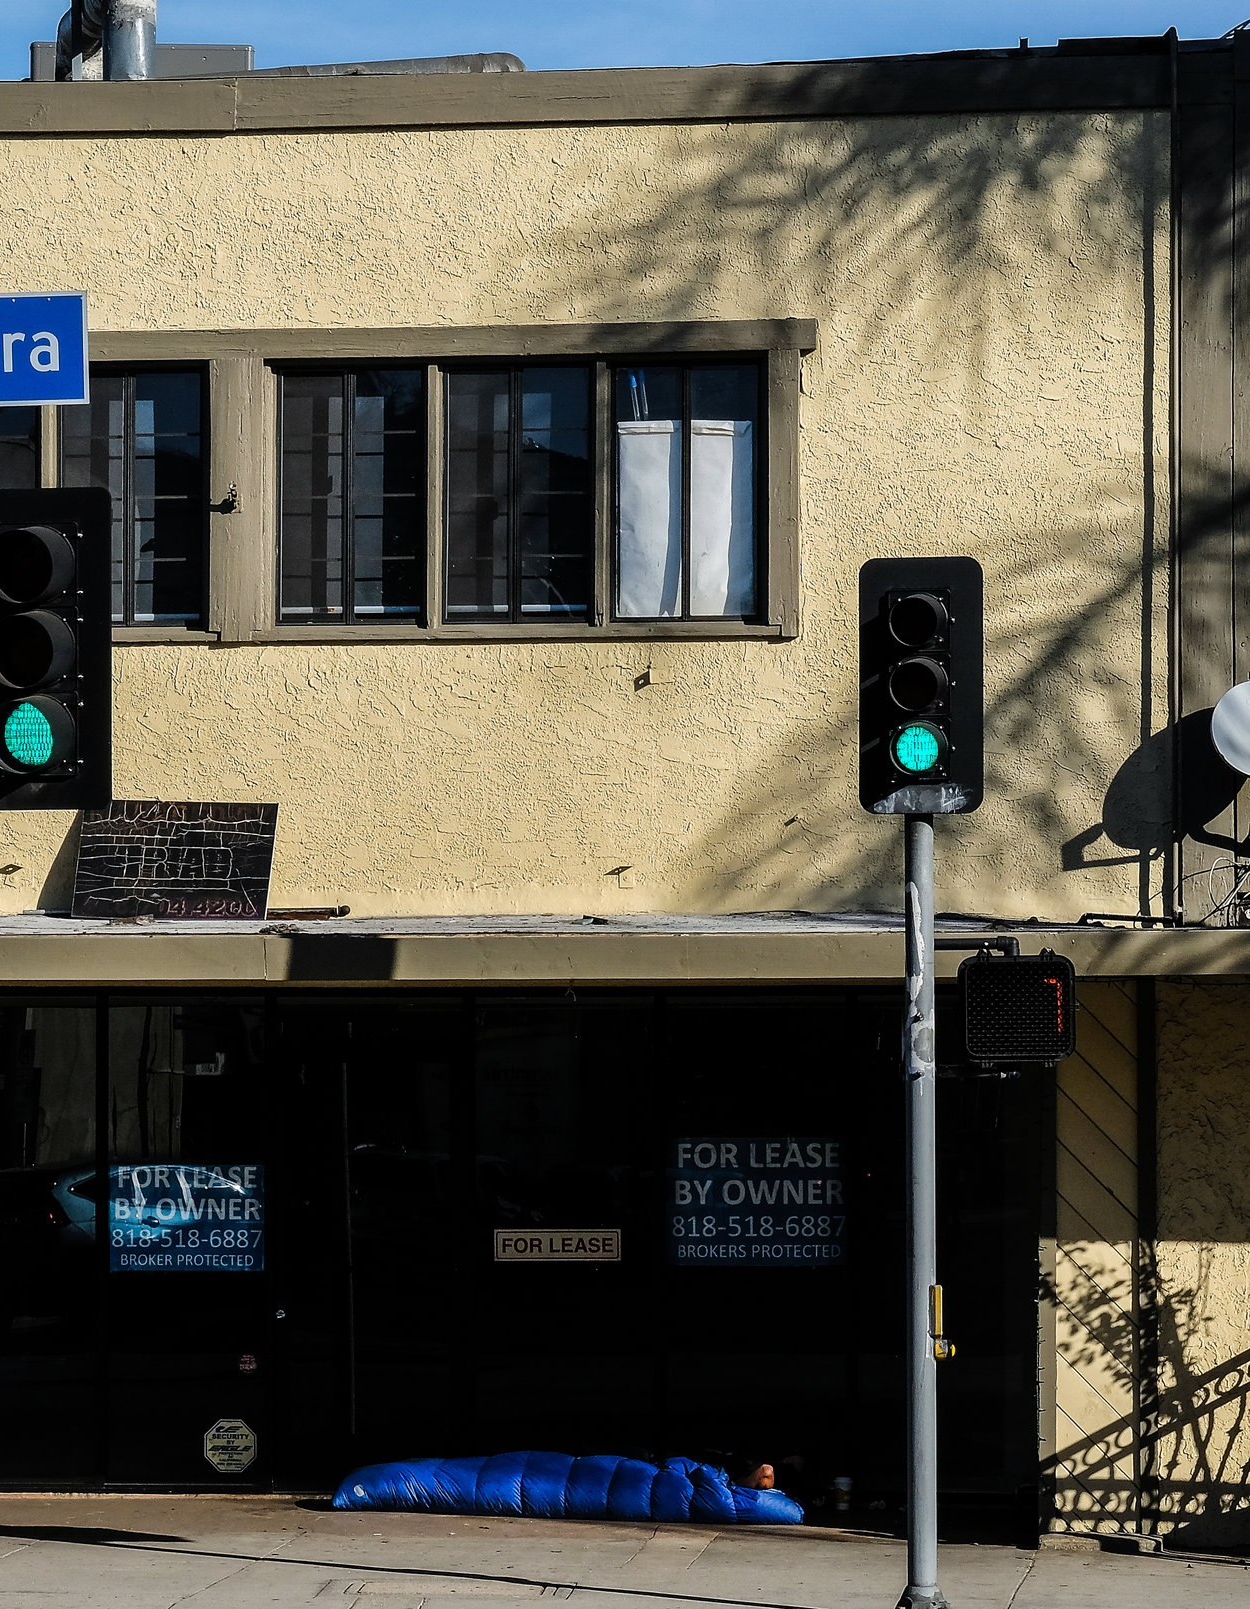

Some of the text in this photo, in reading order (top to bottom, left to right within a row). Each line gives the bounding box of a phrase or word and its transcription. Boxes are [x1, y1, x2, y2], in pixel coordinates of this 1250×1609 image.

[677, 1142, 840, 1168] FOR LEASE
[117, 1166, 257, 1189] FOR LEASE
[675, 1180, 843, 1206] BY OWNER
[115, 1197, 261, 1221] BY OWNER
[672, 1216, 845, 1238] 818-518-6887
[111, 1229, 262, 1249] 818-518-6887
[502, 1237, 614, 1254] FOR LEASE
[120, 1254, 254, 1267] BROKER PROTECTED
[677, 1245, 841, 1259] BROKERS PROTECTED
